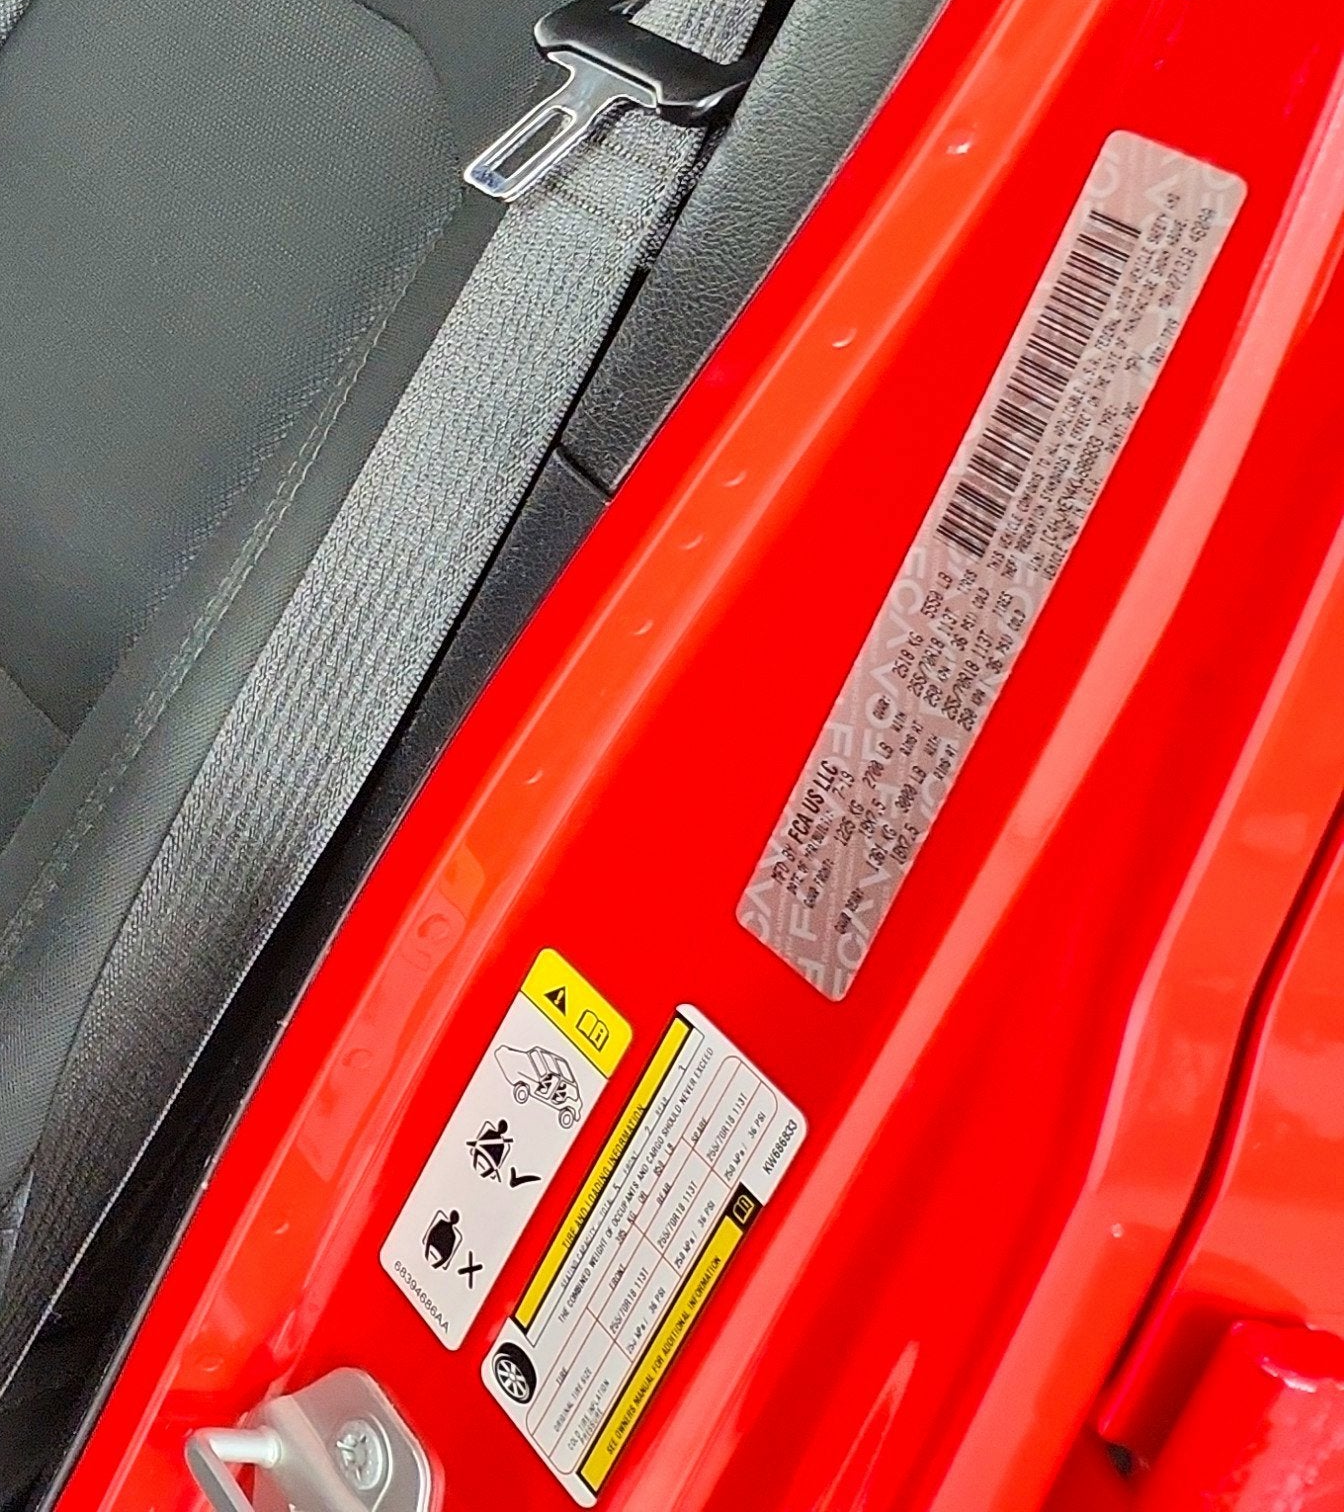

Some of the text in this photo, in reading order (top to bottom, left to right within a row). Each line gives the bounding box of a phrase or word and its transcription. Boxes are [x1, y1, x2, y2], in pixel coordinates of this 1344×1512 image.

[1036, 457, 1051, 468] TO
[1063, 441, 1077, 454] IN
[1072, 506, 1086, 519] IN
[906, 630, 924, 648] KG
[936, 570, 953, 590] LB
[936, 606, 958, 636] 113T
[1006, 608, 1026, 632] COLD
[910, 719, 924, 735] AT
[970, 586, 990, 610] COLD
[970, 628, 994, 659] 113T
[812, 758, 839, 792] LLC
[832, 769, 855, 800] 7-19
[847, 798, 865, 818] KG
[877, 740, 894, 760] LB
[801, 787, 824, 814] US
[865, 842, 888, 872] 1361
[879, 823, 898, 842] KG
[909, 764, 927, 785] LB
[787, 811, 813, 845] FCA
[780, 842, 797, 863] BY
[796, 859, 809, 874] OF
[762, 1118, 797, 1174] KW686833
[557, 1306, 569, 1323] THE
[566, 1267, 591, 1307] COMBINED
[588, 1236, 607, 1268] WEIGHT
[604, 1226, 613, 1239] OF
[610, 1180, 639, 1227] OCCUPANTS
[636, 1163, 649, 1181] AND
[645, 1135, 664, 1164] CARGO
[660, 1103, 682, 1137] SHOULD
[678, 1077, 697, 1105] NEVER
[692, 1046, 713, 1079] EXCEED
[574, 1207, 589, 1229] AND
[608, 1106, 645, 1168] INFORMATION
[626, 1209, 637, 1225] KG
[663, 1141, 675, 1156] LB
[611, 1182, 622, 1193] 5
[648, 1300, 658, 1314] 36
[653, 1286, 666, 1303] PSI
[697, 1214, 707, 1228] 36
[703, 1199, 715, 1216] PSI
[747, 1126, 757, 1139] 36
[753, 1110, 766, 1128] PSI
[570, 1382, 583, 1399] TIRE
[580, 1366, 592, 1384] SIZE
[608, 1288, 637, 1334] 255/70R18
[633, 1266, 649, 1289] 113T
[656, 1202, 685, 1249] 255/70R18
[681, 1179, 697, 1203] 113T
[705, 1114, 735, 1162] 255/70R18
[731, 1091, 747, 1115] 113T
[393, 1259, 451, 1335] 68394686AA
[606, 1256, 721, 1455] SEE OWNERS MANUAL FOR ADDITIONAL INFORMATION
[566, 1429, 581, 1451] COLD
[577, 1413, 590, 1431] TIRE
